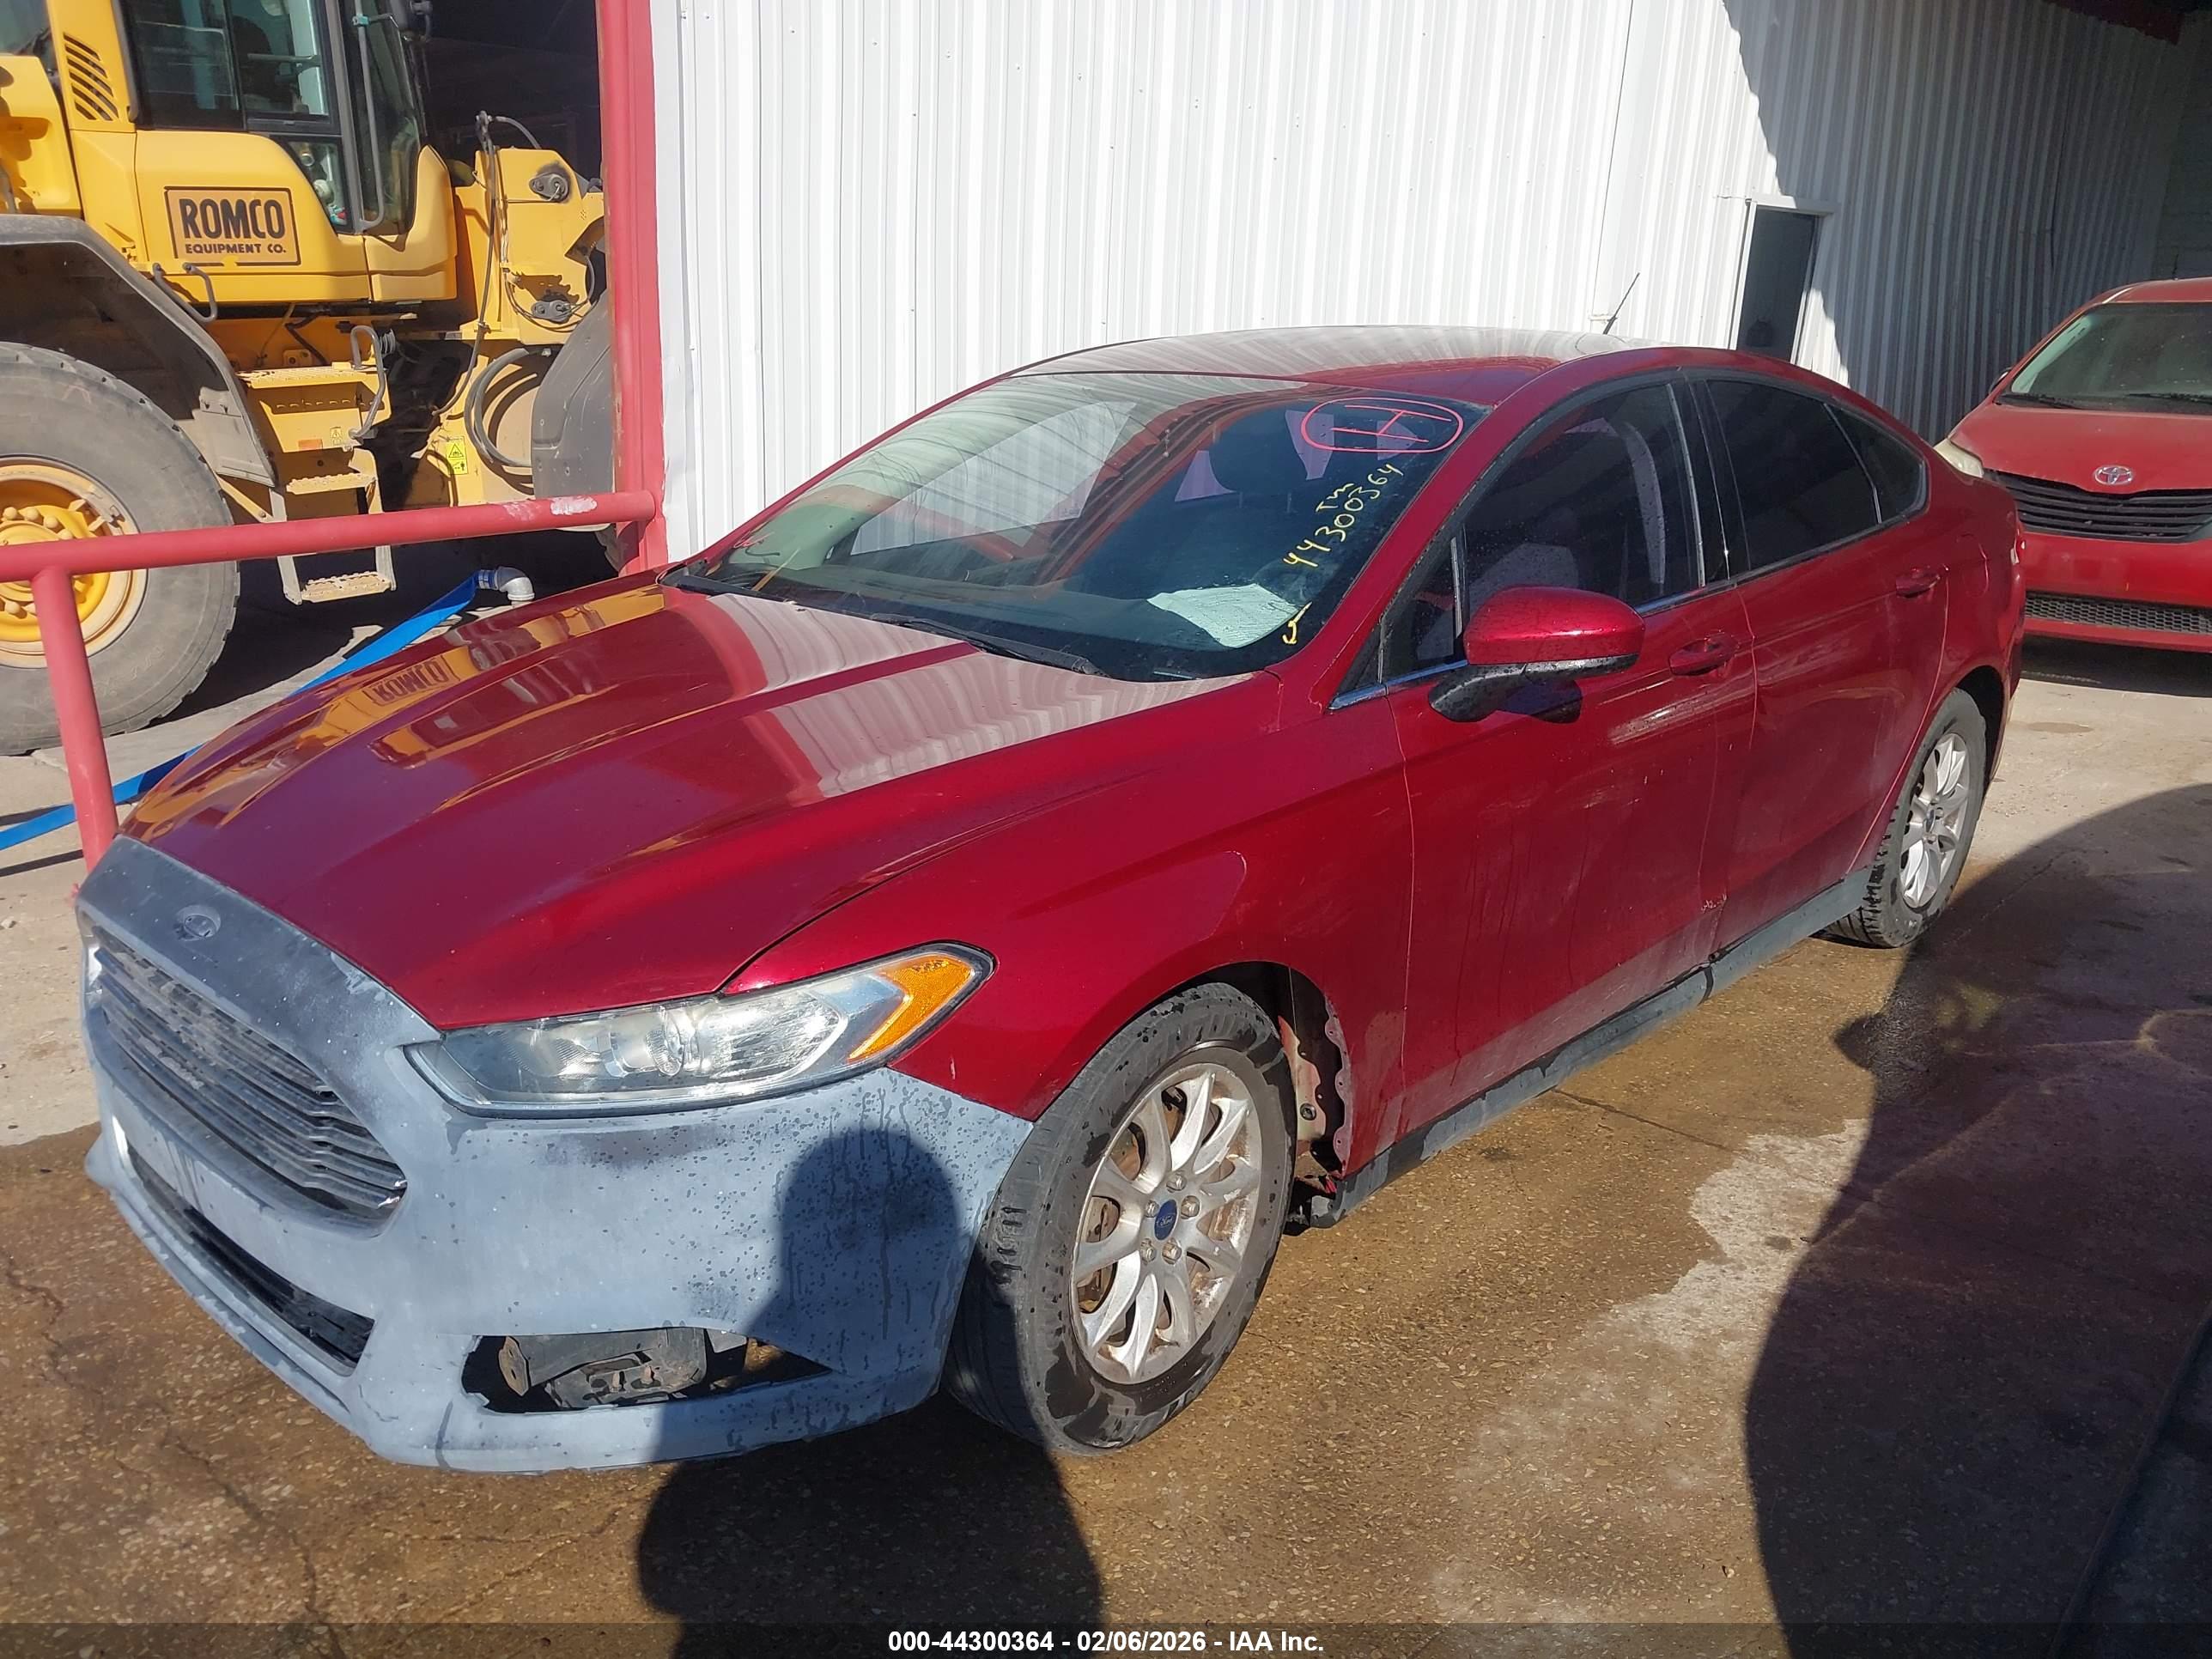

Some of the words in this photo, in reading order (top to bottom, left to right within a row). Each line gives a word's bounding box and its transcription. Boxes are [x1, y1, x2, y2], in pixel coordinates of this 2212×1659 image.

[179, 198, 286, 239] ROMCO
[185, 243, 261, 253] EQUIPMENT
[267, 243, 287, 253] CO.
[1283, 464, 1404, 567] 44300364
